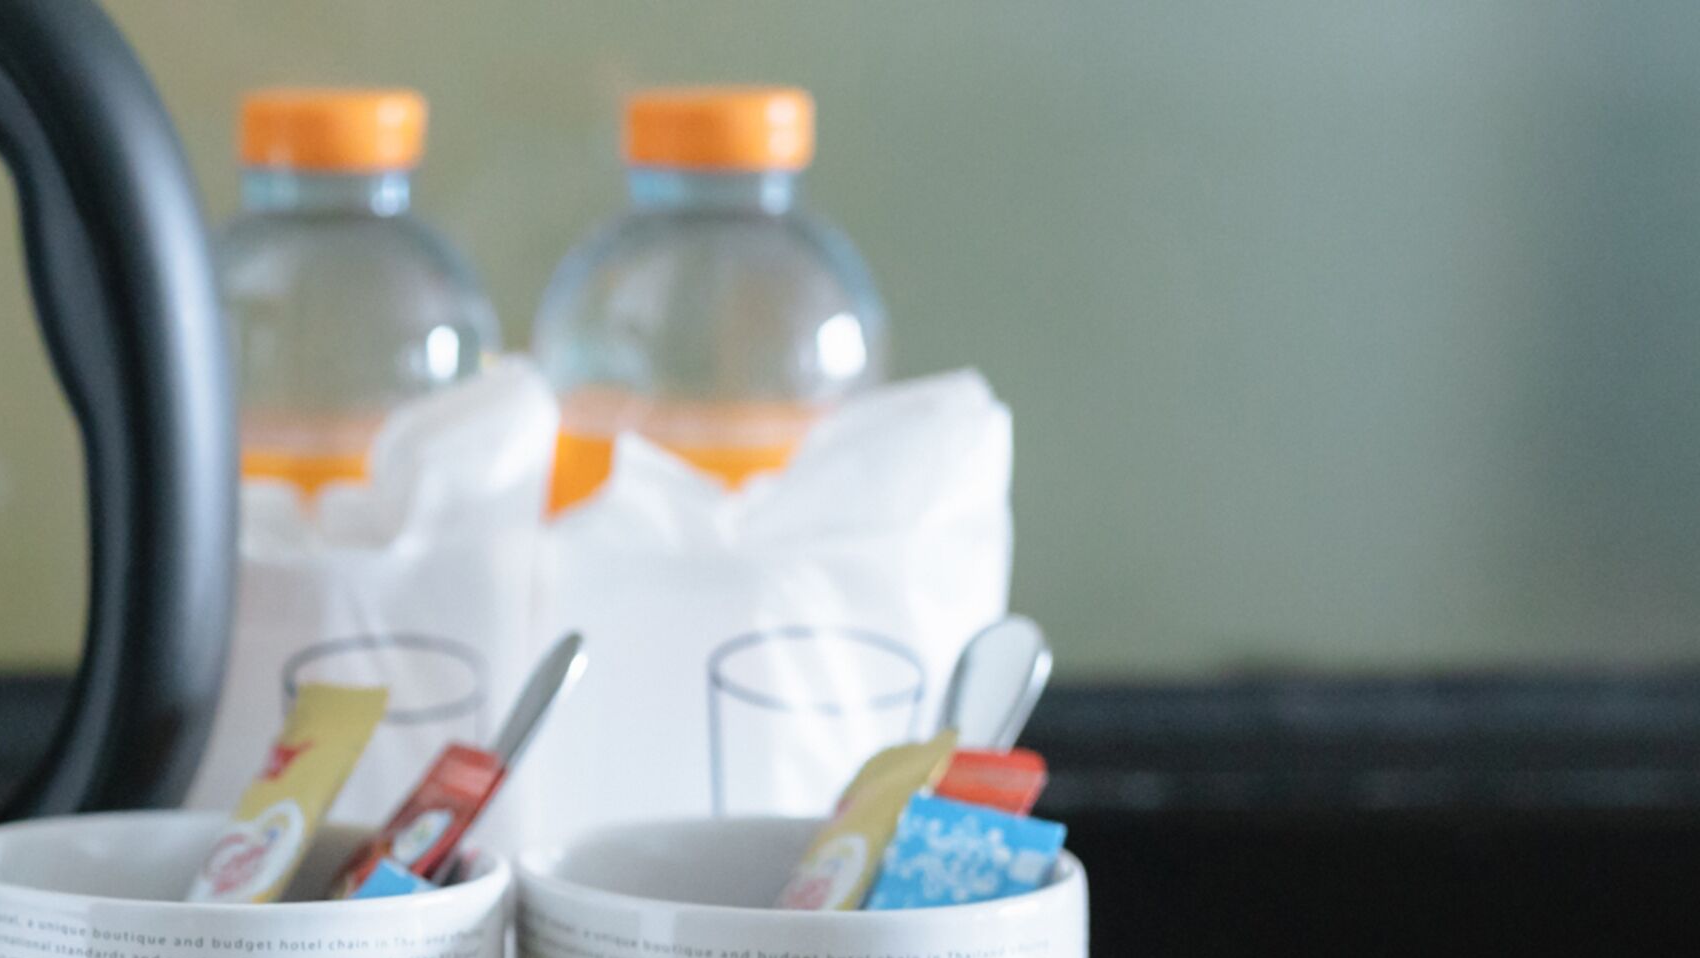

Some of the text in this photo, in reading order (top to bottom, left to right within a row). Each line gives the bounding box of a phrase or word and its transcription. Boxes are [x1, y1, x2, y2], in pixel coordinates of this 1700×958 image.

[38, 921, 86, 937] unique
[92, 927, 167, 947] boutique
[173, 935, 205, 949] and
[211, 936, 272, 952] budget
[279, 938, 322, 951] hotel
[328, 939, 369, 951] chain
[375, 938, 388, 950] in
[642, 937, 713, 958] boutique
